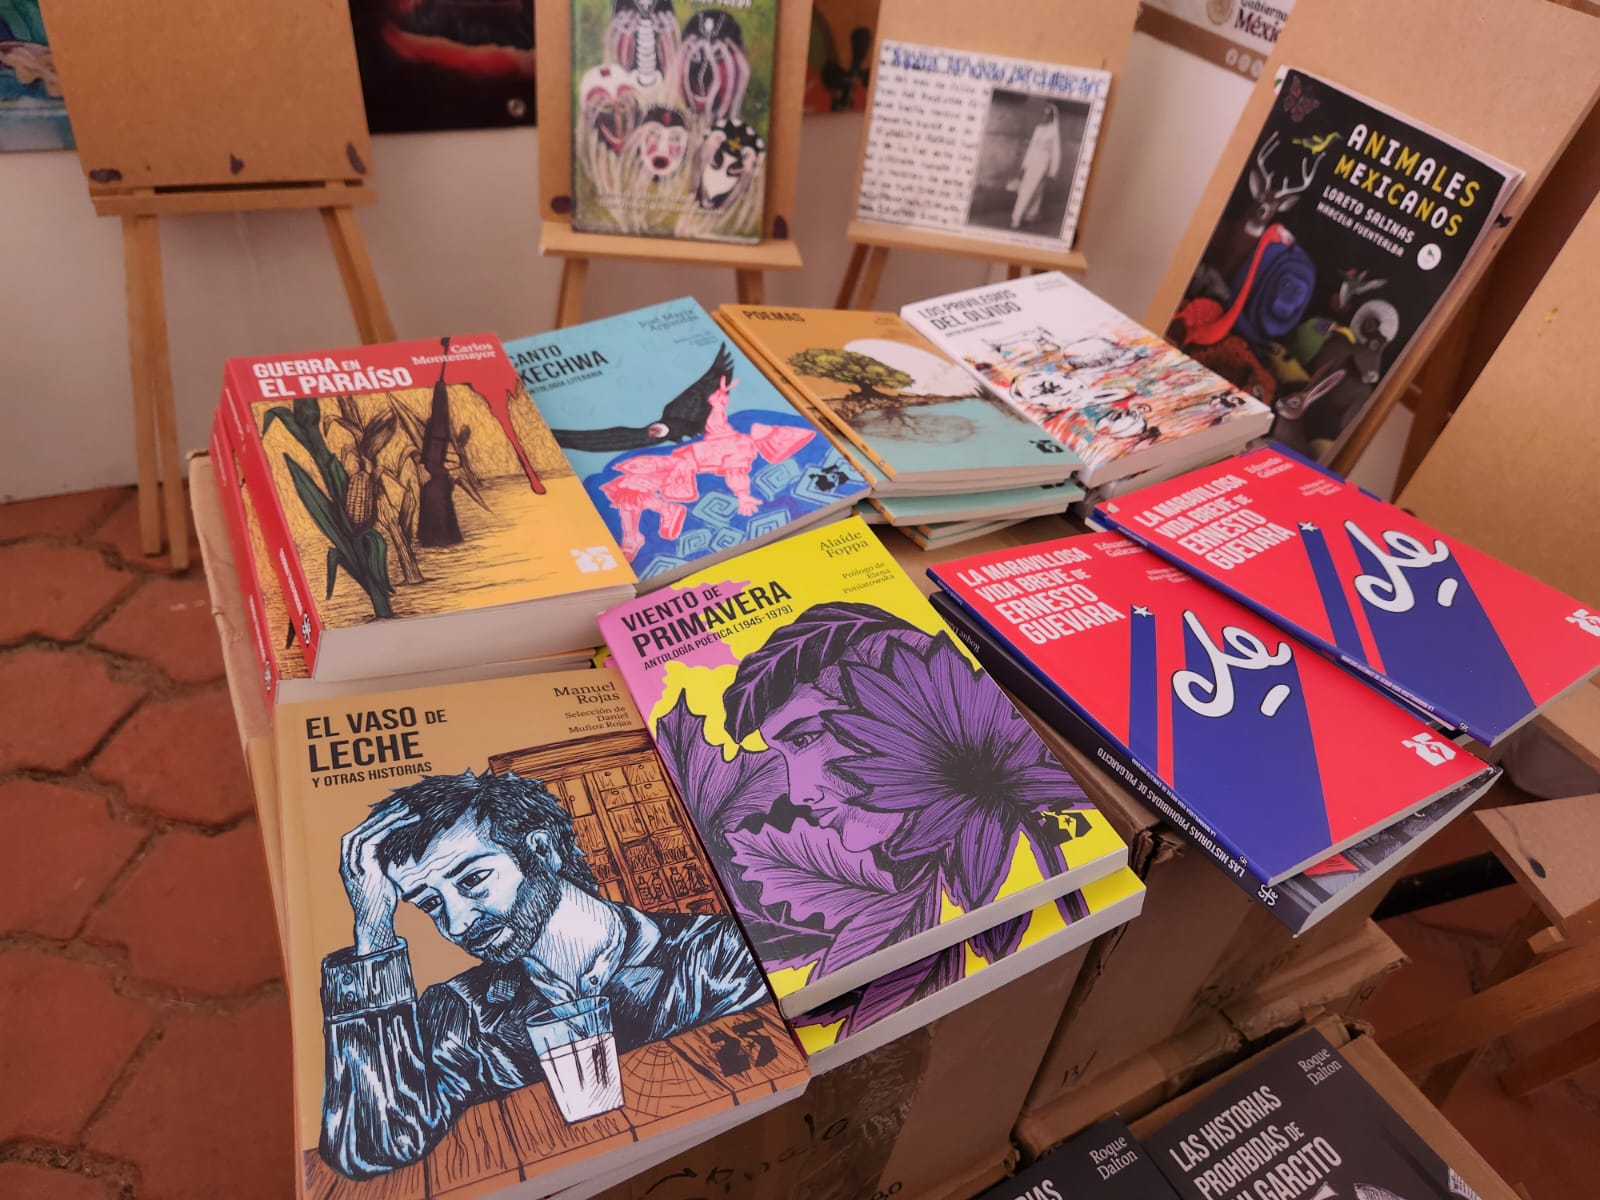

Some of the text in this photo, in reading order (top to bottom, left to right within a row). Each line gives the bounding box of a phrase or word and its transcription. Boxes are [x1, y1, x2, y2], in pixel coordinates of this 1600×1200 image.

[1234, 8, 1282, 43] Méxi
[1347, 123, 1480, 208] ANIMALES
[1334, 154, 1464, 237] MEXICANOS
[1322, 185, 1416, 244] LORETO SALINAS
[743, 310, 805, 323] POEMAS
[917, 304, 946, 319] LOS
[930, 314, 966, 331] DEL
[962, 301, 1022, 323] OLVIDO
[411, 350, 496, 366] Montemayor
[450, 342, 494, 354] Carlos
[252, 357, 361, 379] GUERRA EN
[257, 365, 413, 398] EL PARAÍSO
[518, 349, 610, 386] KECHWA
[1133, 474, 1248, 528] LA MARAVILLOSA
[1154, 516, 1200, 540] VIDA
[1190, 494, 1242, 525] BREVE
[1232, 493, 1254, 506] DE
[820, 531, 863, 551] Alaíde
[826, 540, 869, 558] Foppa
[1176, 507, 1269, 556] ERNESTO
[1204, 520, 1297, 571] GUEVARA
[957, 546, 1093, 588] LA MARAVILLOSA
[974, 580, 1023, 604] VIDA
[1016, 567, 1077, 593] BREVE
[1068, 567, 1092, 581] DE
[620, 585, 723, 633] VIENTO DE
[631, 580, 793, 659] PRIMAVERA
[994, 583, 1101, 626] ERNESTO
[1017, 600, 1127, 646] GUEVARA
[643, 640, 695, 672] ANTOLOGÍA
[695, 626, 734, 649] POÉTICA
[553, 681, 617, 697] Manuel
[576, 692, 621, 705] Rojas
[305, 705, 449, 740] EL VASO DE
[564, 705, 626, 720] Selección de
[568, 719, 633, 735] Muñoz Rojas
[596, 711, 630, 722] Daniel
[307, 730, 424, 773] LECHE
[311, 761, 433, 788] Y OTRAS HISTORIAS
[1095, 746, 1246, 878] LAS HISTORIAS PROHIBIDAS DE PULGARCITO
[1297, 1048, 1331, 1073] Roque
[1306, 1060, 1342, 1086] Dalton
[1168, 1085, 1283, 1173] LAS HISTORIAS
[1089, 1136, 1128, 1165] Roque
[1096, 1150, 1139, 1180] Dalton
[1193, 1121, 1305, 1200] PROHIBIDAS DE
[1231, 1136, 1343, 1200] GARCITO
